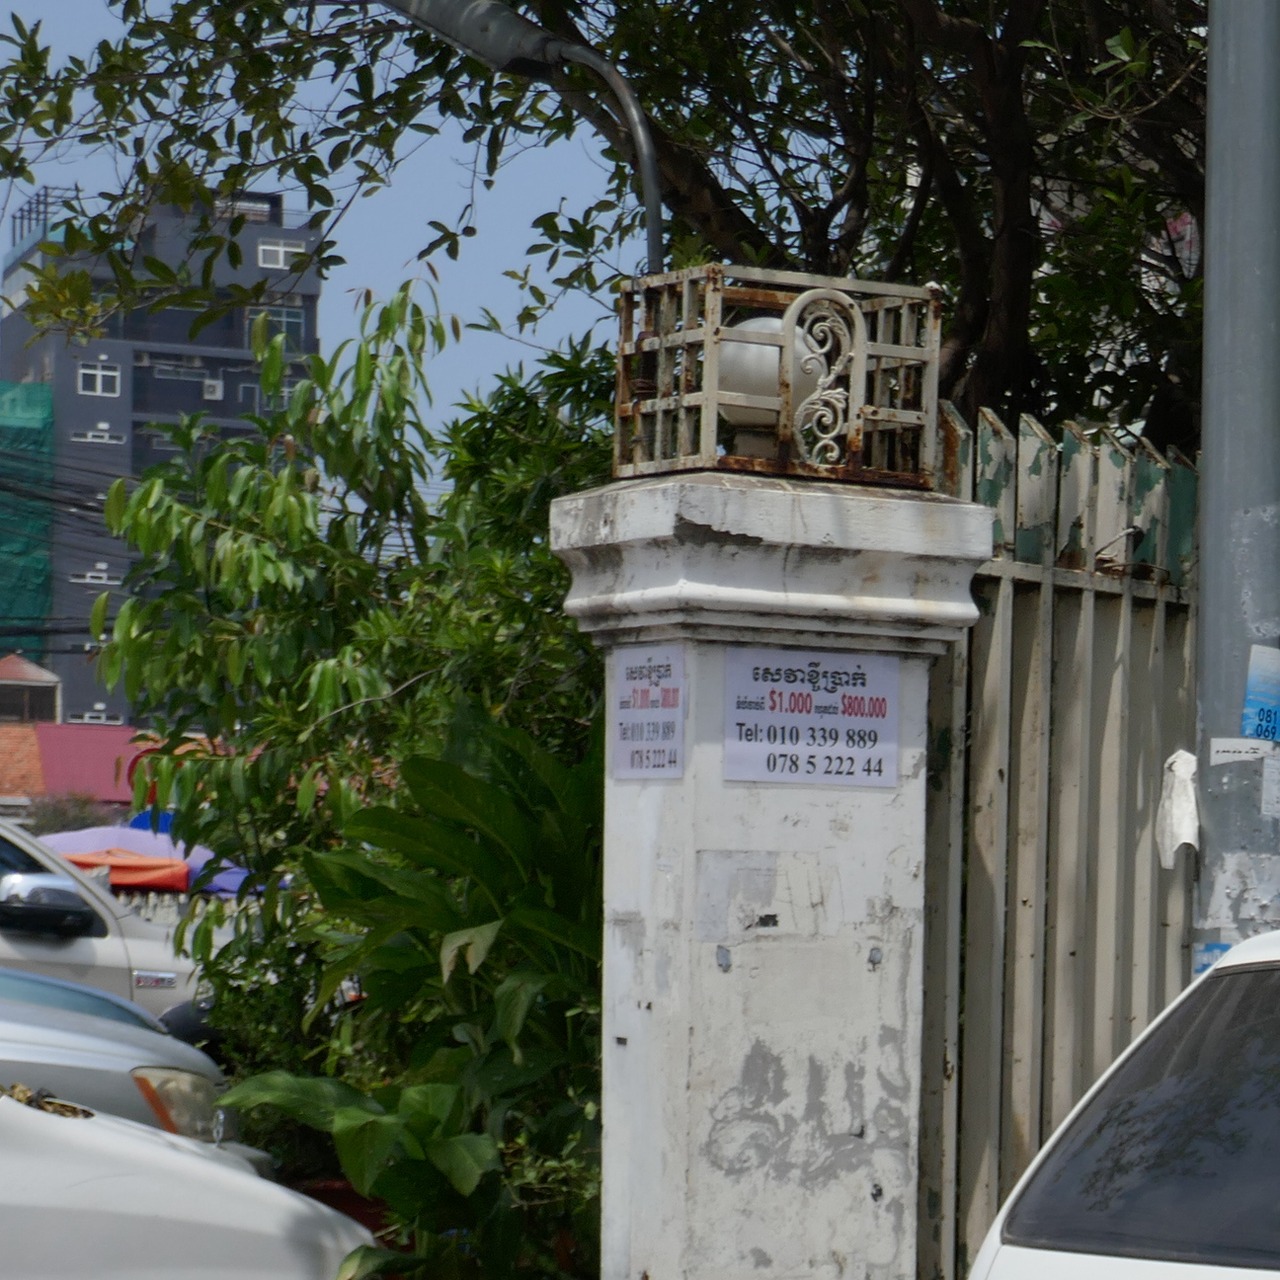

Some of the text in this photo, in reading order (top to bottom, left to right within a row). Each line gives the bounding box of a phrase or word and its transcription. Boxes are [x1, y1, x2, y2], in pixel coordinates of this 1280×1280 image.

[769, 689, 813, 715] $1.000
[841, 693, 887, 719] $800.000
[1257, 707, 1278, 725] 081
[736, 722, 878, 750] Tel: 010 339 889
[1255, 723, 1277, 740] 069
[766, 753, 884, 778] 078 5 222 44
